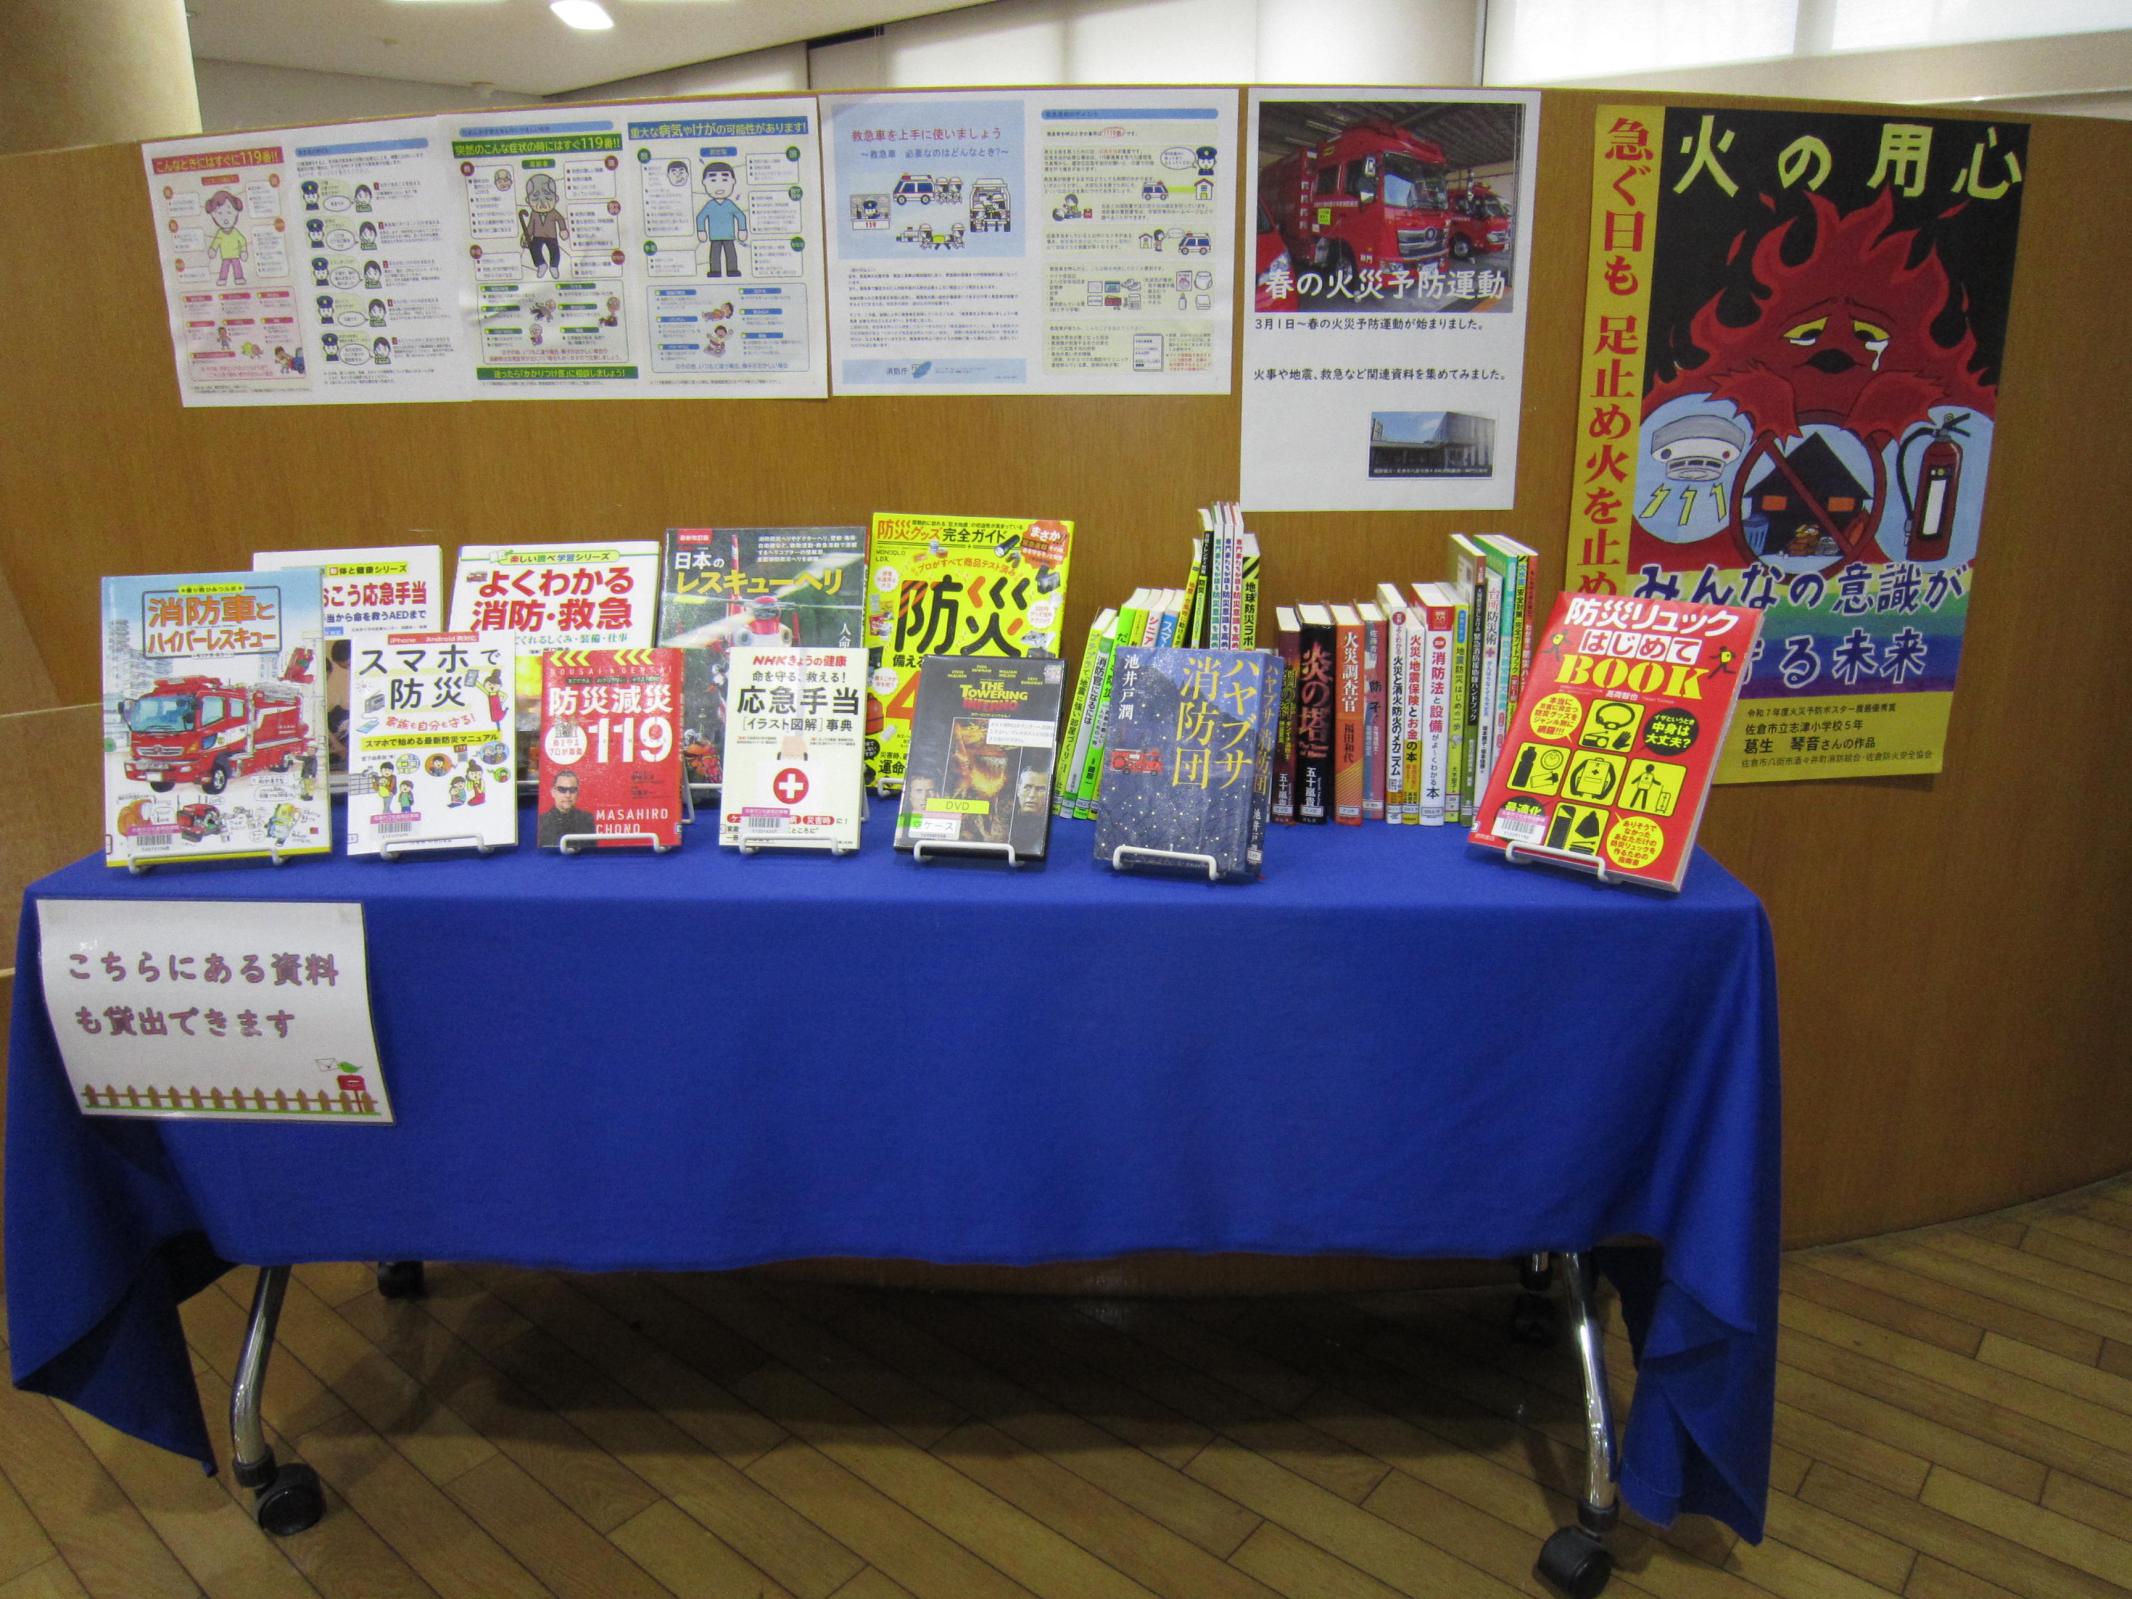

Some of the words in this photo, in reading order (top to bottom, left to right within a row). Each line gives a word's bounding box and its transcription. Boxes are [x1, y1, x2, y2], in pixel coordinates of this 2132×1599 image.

[851, 127, 1001, 142] 救急車を上手に使いましょう
[1673, 115, 2022, 200] 火の用心
[1604, 117, 1653, 296] 急ぐ日も
[1265, 269, 1506, 300] 春の火災予防運動
[674, 552, 725, 570] 日本の
[479, 566, 634, 598] よくわかる
[676, 568, 844, 596] レスキューヘリ
[1633, 561, 1970, 615] みんなの意識が
[148, 594, 275, 628] 消防車と
[324, 610, 427, 624] 当から命を救うAEDまで
[471, 597, 633, 632] 消防・救急
[894, 574, 1031, 657] 防災
[1243, 582, 1256, 647] 地球防災ラボ
[1562, 597, 1740, 637] 防災リュック
[359, 644, 502, 676] スマホで
[1582, 631, 1699, 662] はじめて
[1118, 654, 1140, 721] 池井戸潤
[1342, 631, 1360, 714] 火災調査官
[1553, 654, 1711, 700] BOOK
[390, 676, 466, 710] 防災
[548, 685, 673, 716] 防災減災
[737, 686, 861, 715] 応急手当
[588, 716, 673, 763] 119
[1172, 655, 1221, 790] 消防団
[1215, 659, 1261, 790] ハヤブサ
[1652, 721, 1691, 736] 中身は
[1645, 731, 1692, 750] 大丈夫?
[596, 808, 670, 820] MASAHIRO
[945, 801, 970, 811] DVD
[596, 824, 641, 834] CHONO
[70, 951, 340, 987] こちらにある資料
[75, 1004, 296, 1039] も貸出できます
